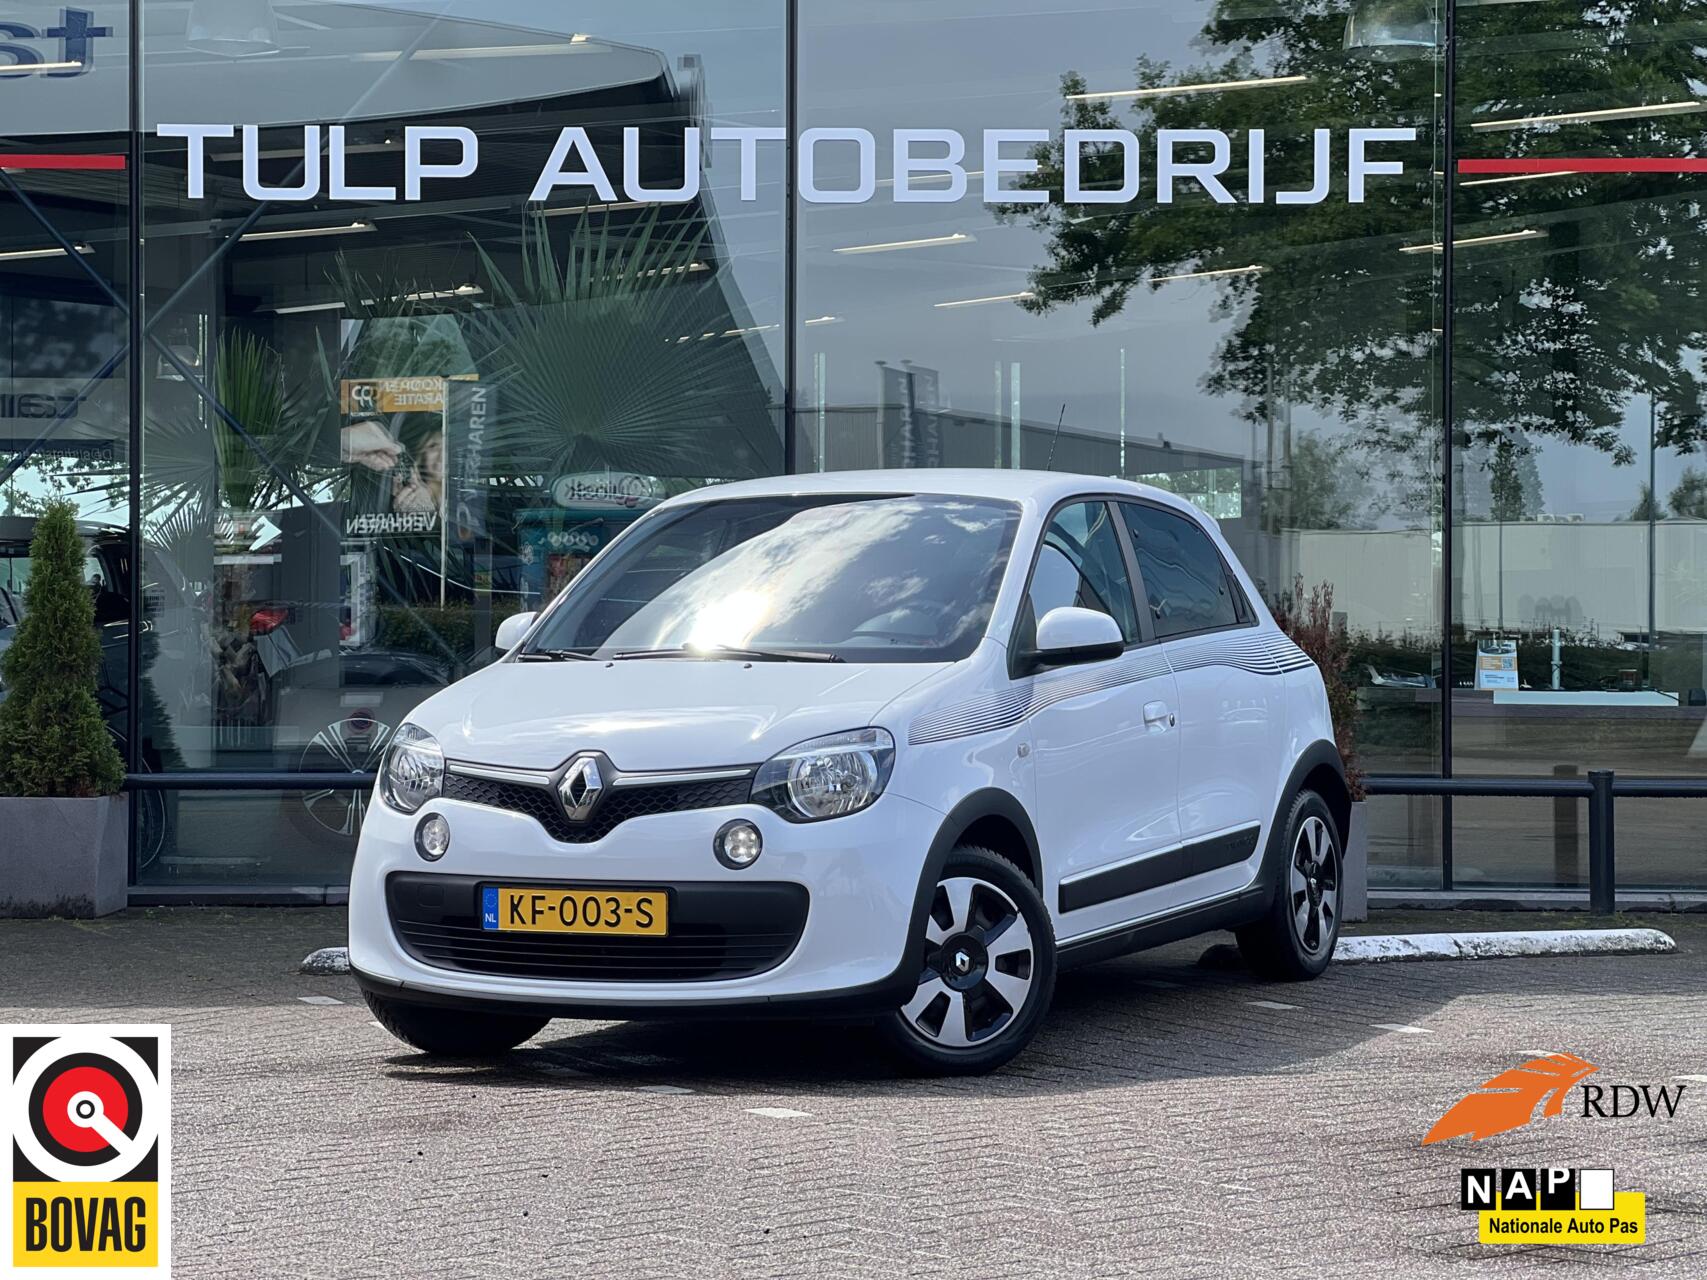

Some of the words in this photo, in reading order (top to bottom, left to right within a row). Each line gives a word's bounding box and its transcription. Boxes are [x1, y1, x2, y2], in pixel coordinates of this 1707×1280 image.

[156, 124, 478, 201] TULP
[530, 127, 1416, 204] AUTOBEDRIJF
[485, 913, 497, 923] NL
[509, 894, 654, 929] KF-003-S
